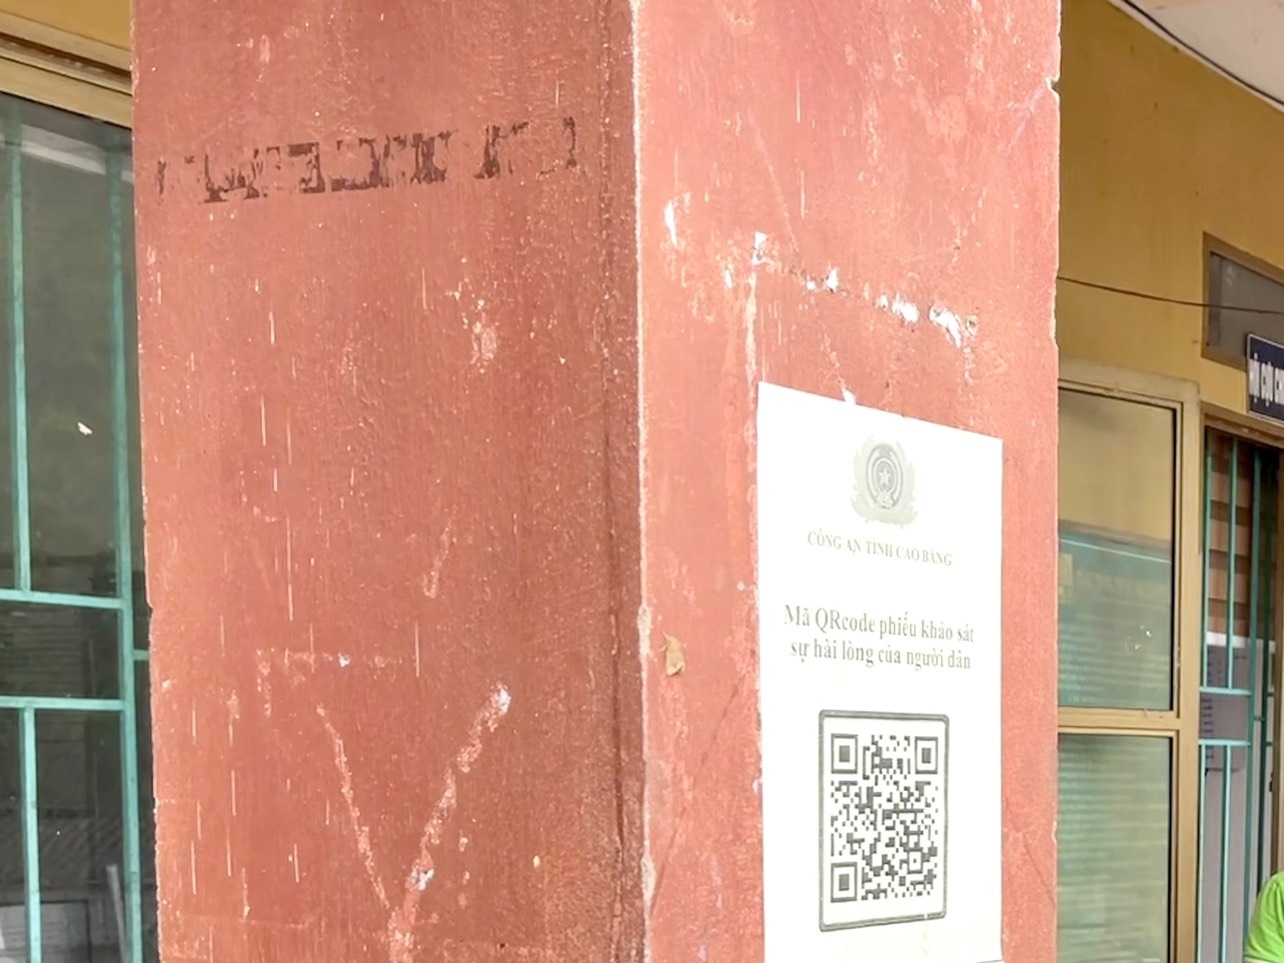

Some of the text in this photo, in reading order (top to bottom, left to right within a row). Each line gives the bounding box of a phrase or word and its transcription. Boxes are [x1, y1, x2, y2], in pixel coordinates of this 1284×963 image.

[807, 528, 842, 550] CÔNG
[845, 538, 861, 556] AN
[865, 538, 893, 557] TỈNH
[896, 545, 920, 561] CAO
[784, 604, 974, 643] Mã QRcode phiếu khảo sát
[790, 638, 971, 671] sự hài lòng của người dân
